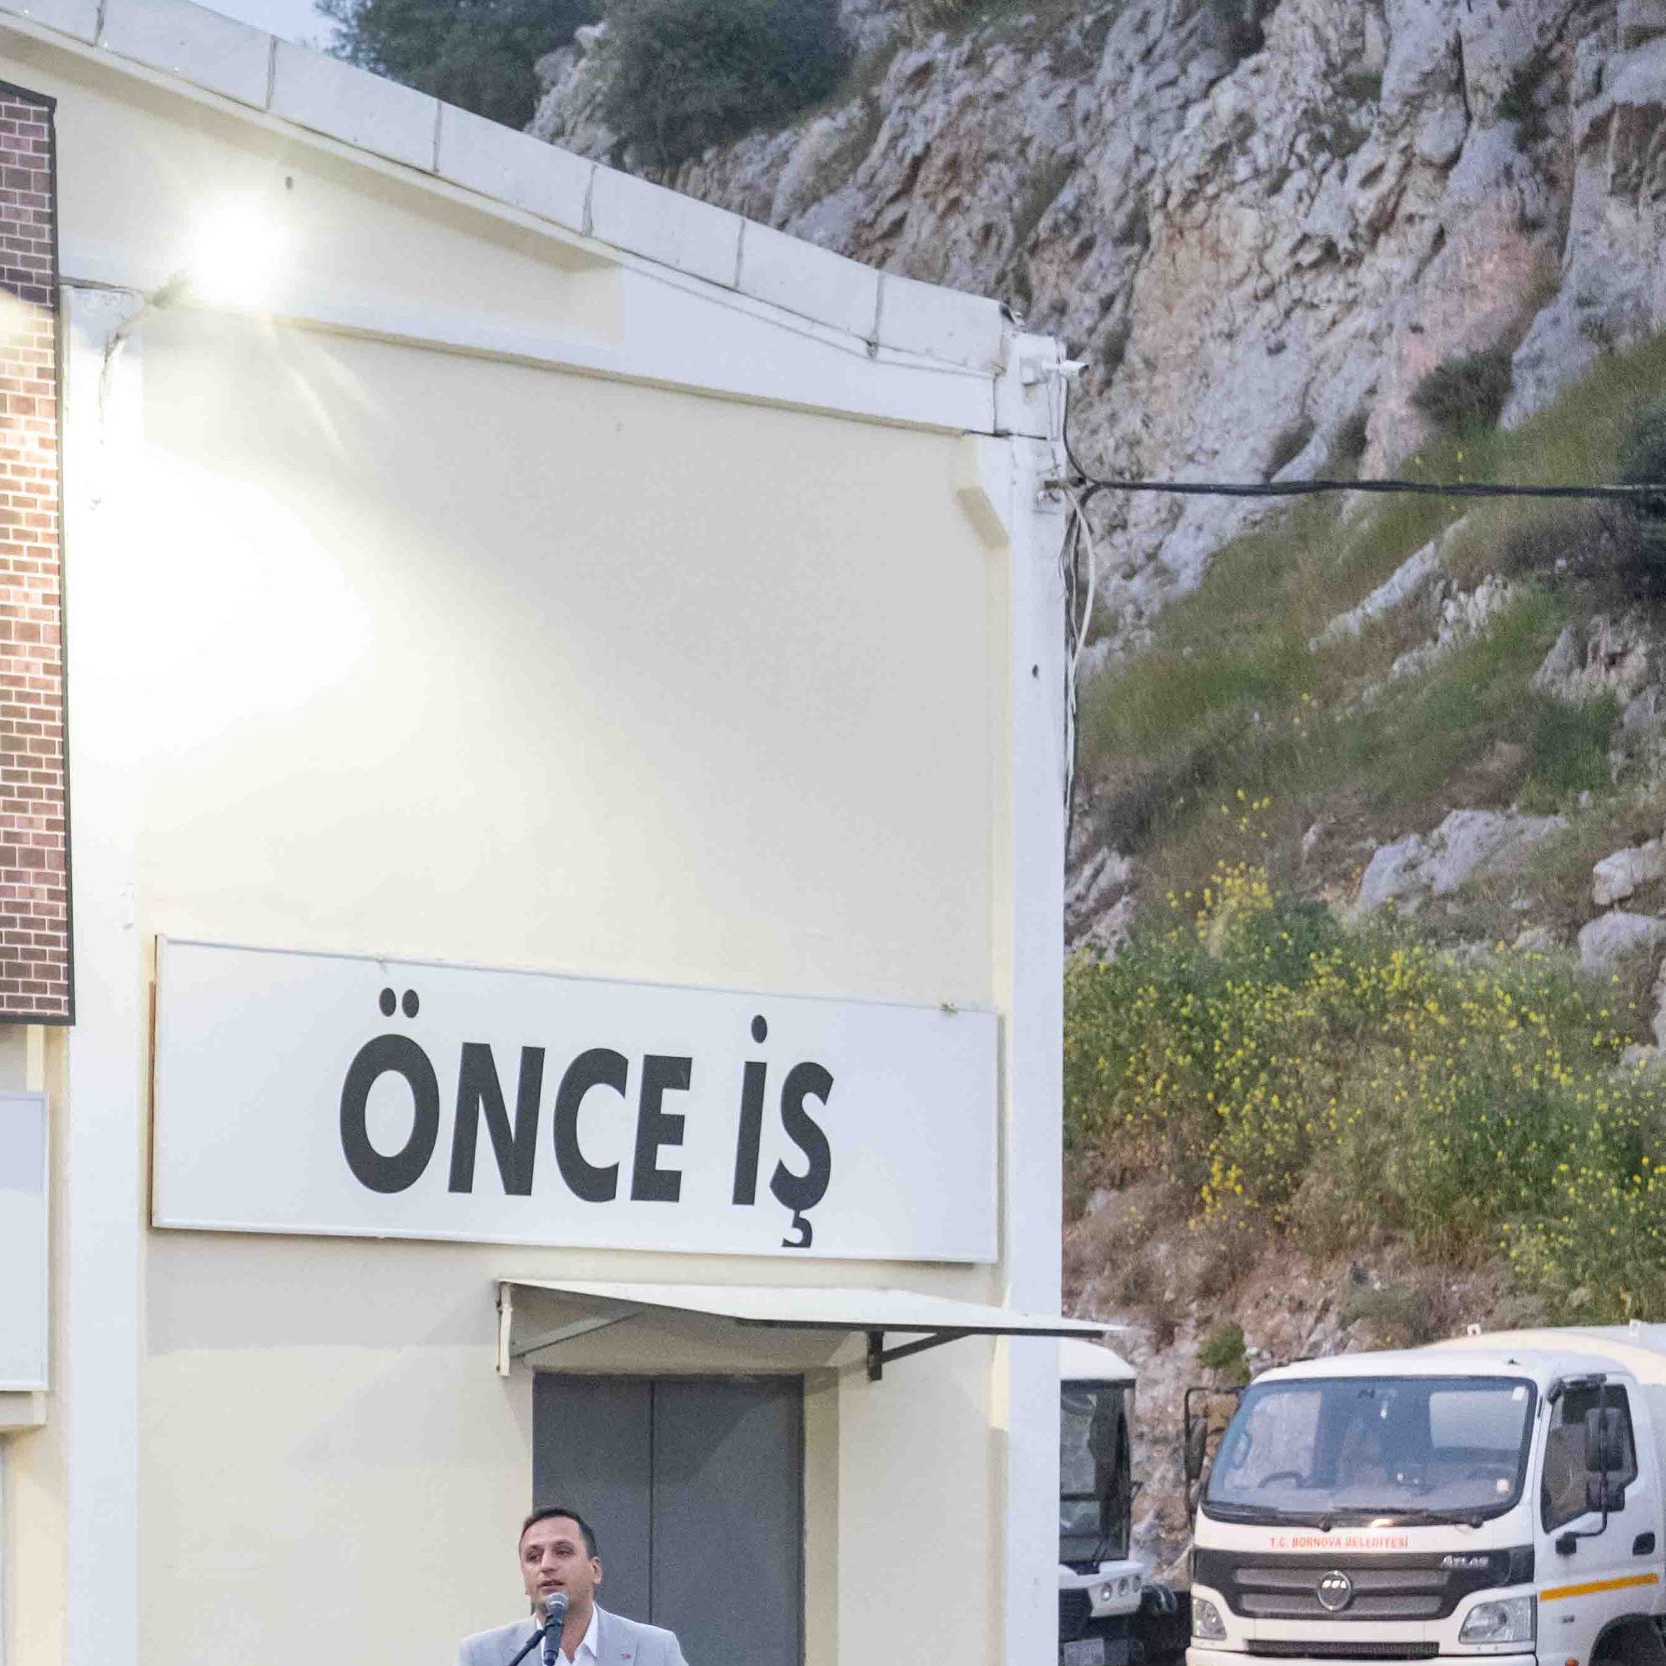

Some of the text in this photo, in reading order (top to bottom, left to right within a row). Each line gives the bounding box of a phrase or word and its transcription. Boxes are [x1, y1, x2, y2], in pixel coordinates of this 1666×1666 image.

[341, 988, 834, 1248] ÖNCE İŞ
[1292, 1536, 1341, 1548] BORNOVA
